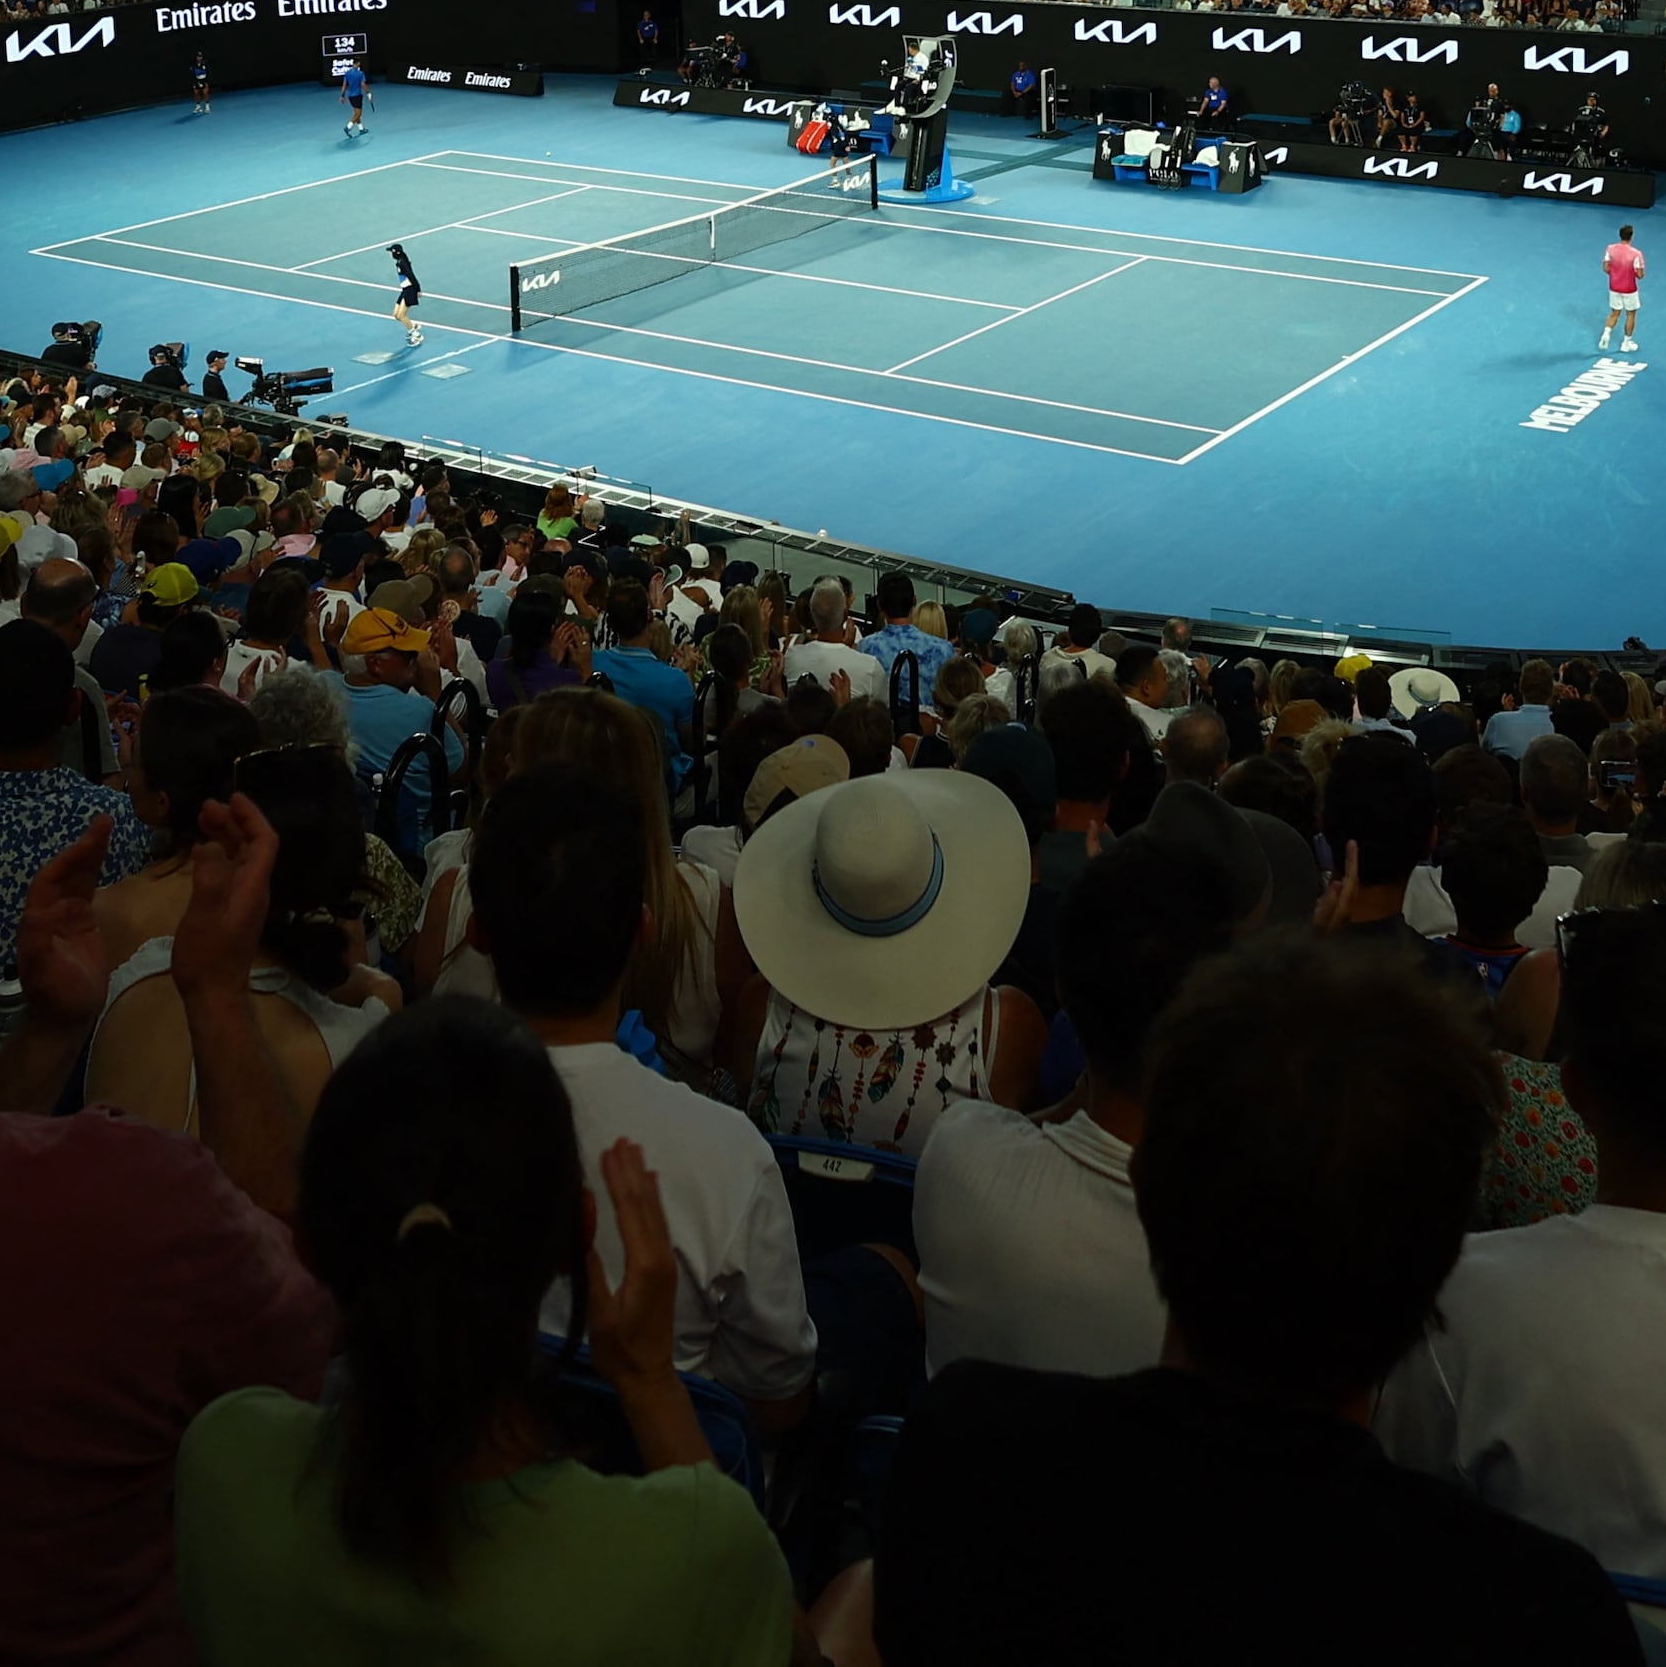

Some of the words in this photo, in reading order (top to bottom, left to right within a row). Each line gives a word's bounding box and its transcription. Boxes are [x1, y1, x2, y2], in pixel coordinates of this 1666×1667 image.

[156, 1, 256, 32] Emirates
[830, 3, 900, 27] KIA
[947, 11, 1023, 36] KIA
[6, 16, 114, 62] KIA
[335, 37, 355, 48] 134
[1075, 19, 1156, 44] KIA
[1213, 27, 1301, 54] KIA
[1362, 36, 1458, 64] KIA
[1524, 46, 1628, 75] KIA
[407, 65, 452, 83] Emirates
[465, 71, 511, 89] Emirates
[640, 88, 690, 106] KIA
[1364, 156, 1438, 179] KIA
[1523, 171, 1604, 195] KIA
[522, 270, 560, 292] KIA
[1518, 357, 1649, 433] MELBOURNE
